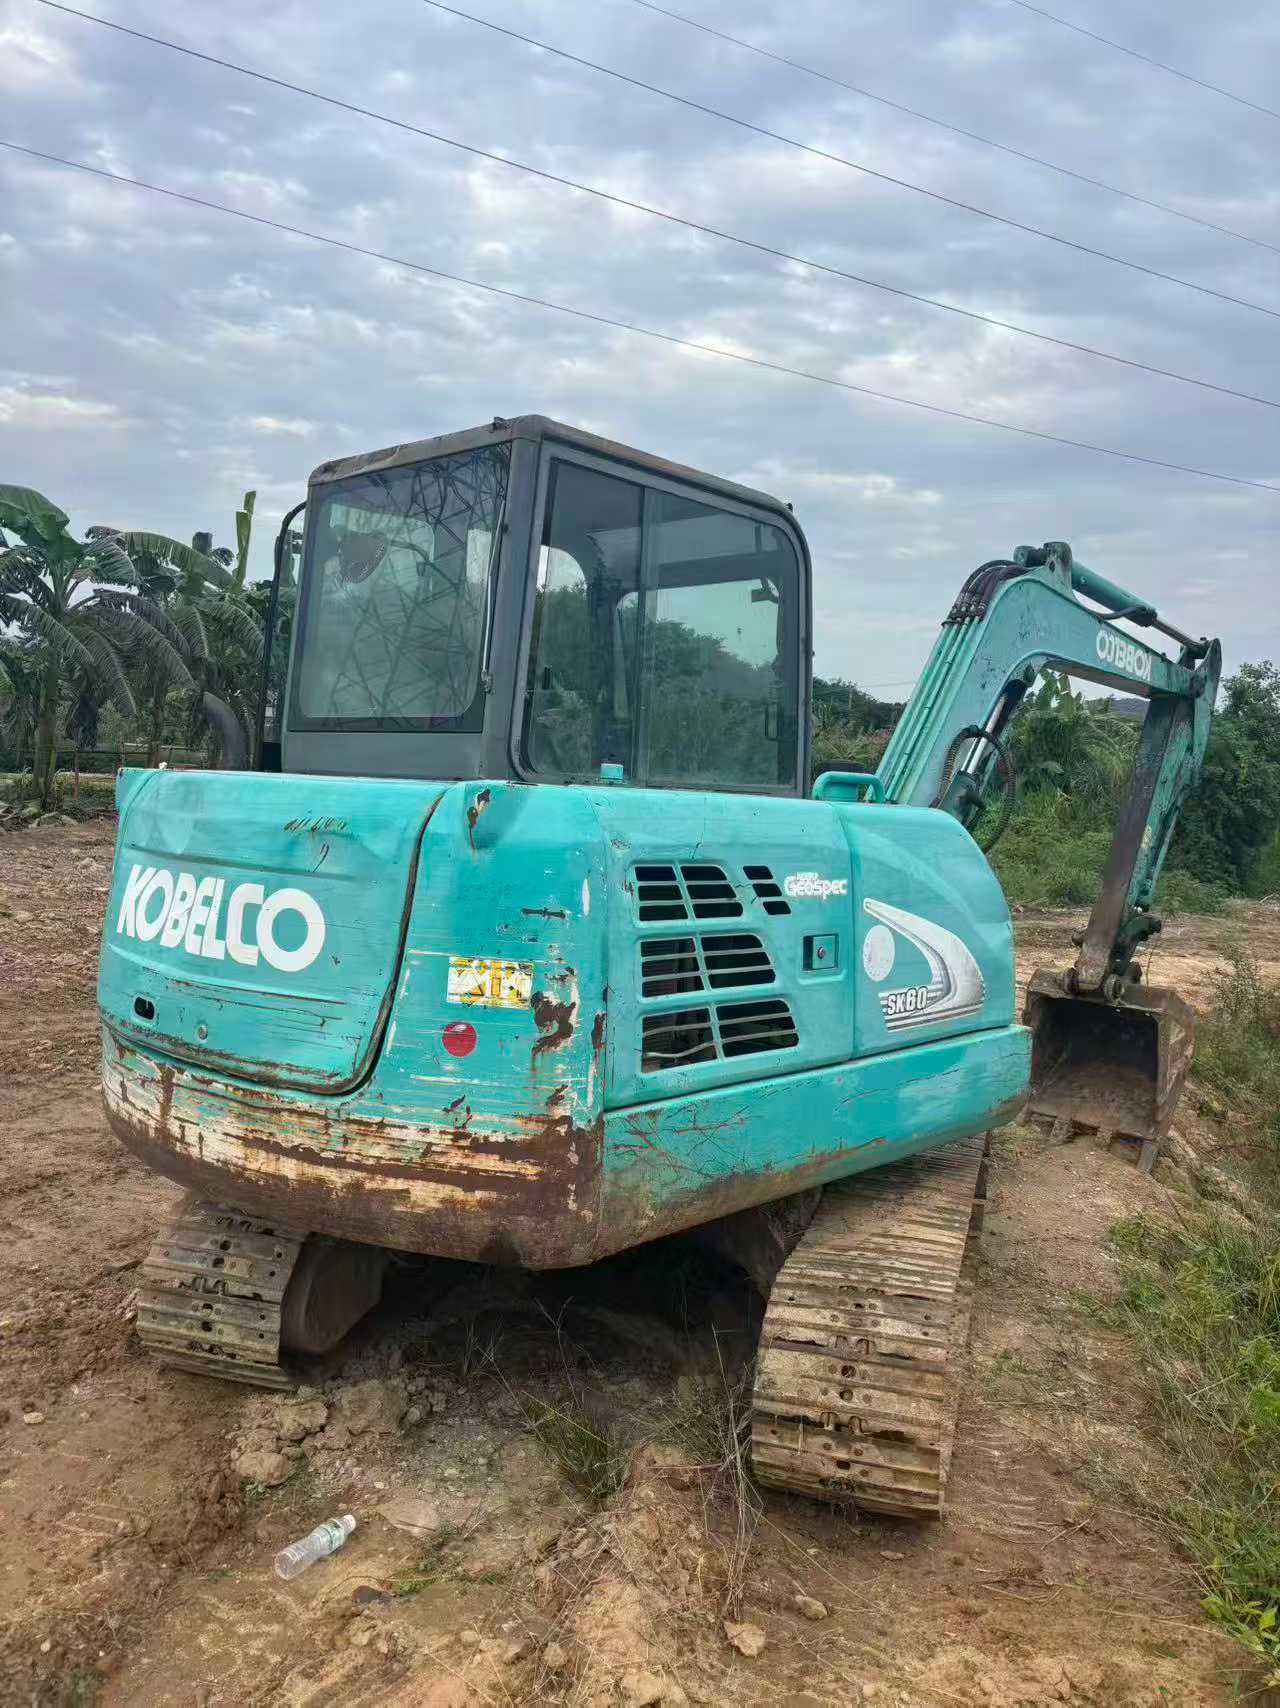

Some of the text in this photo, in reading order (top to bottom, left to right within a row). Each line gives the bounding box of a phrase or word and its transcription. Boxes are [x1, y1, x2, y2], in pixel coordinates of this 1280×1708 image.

[1096, 630, 1152, 681] KOBELCO
[116, 864, 326, 972] KOBELCO
[887, 986, 928, 1015] SK60
